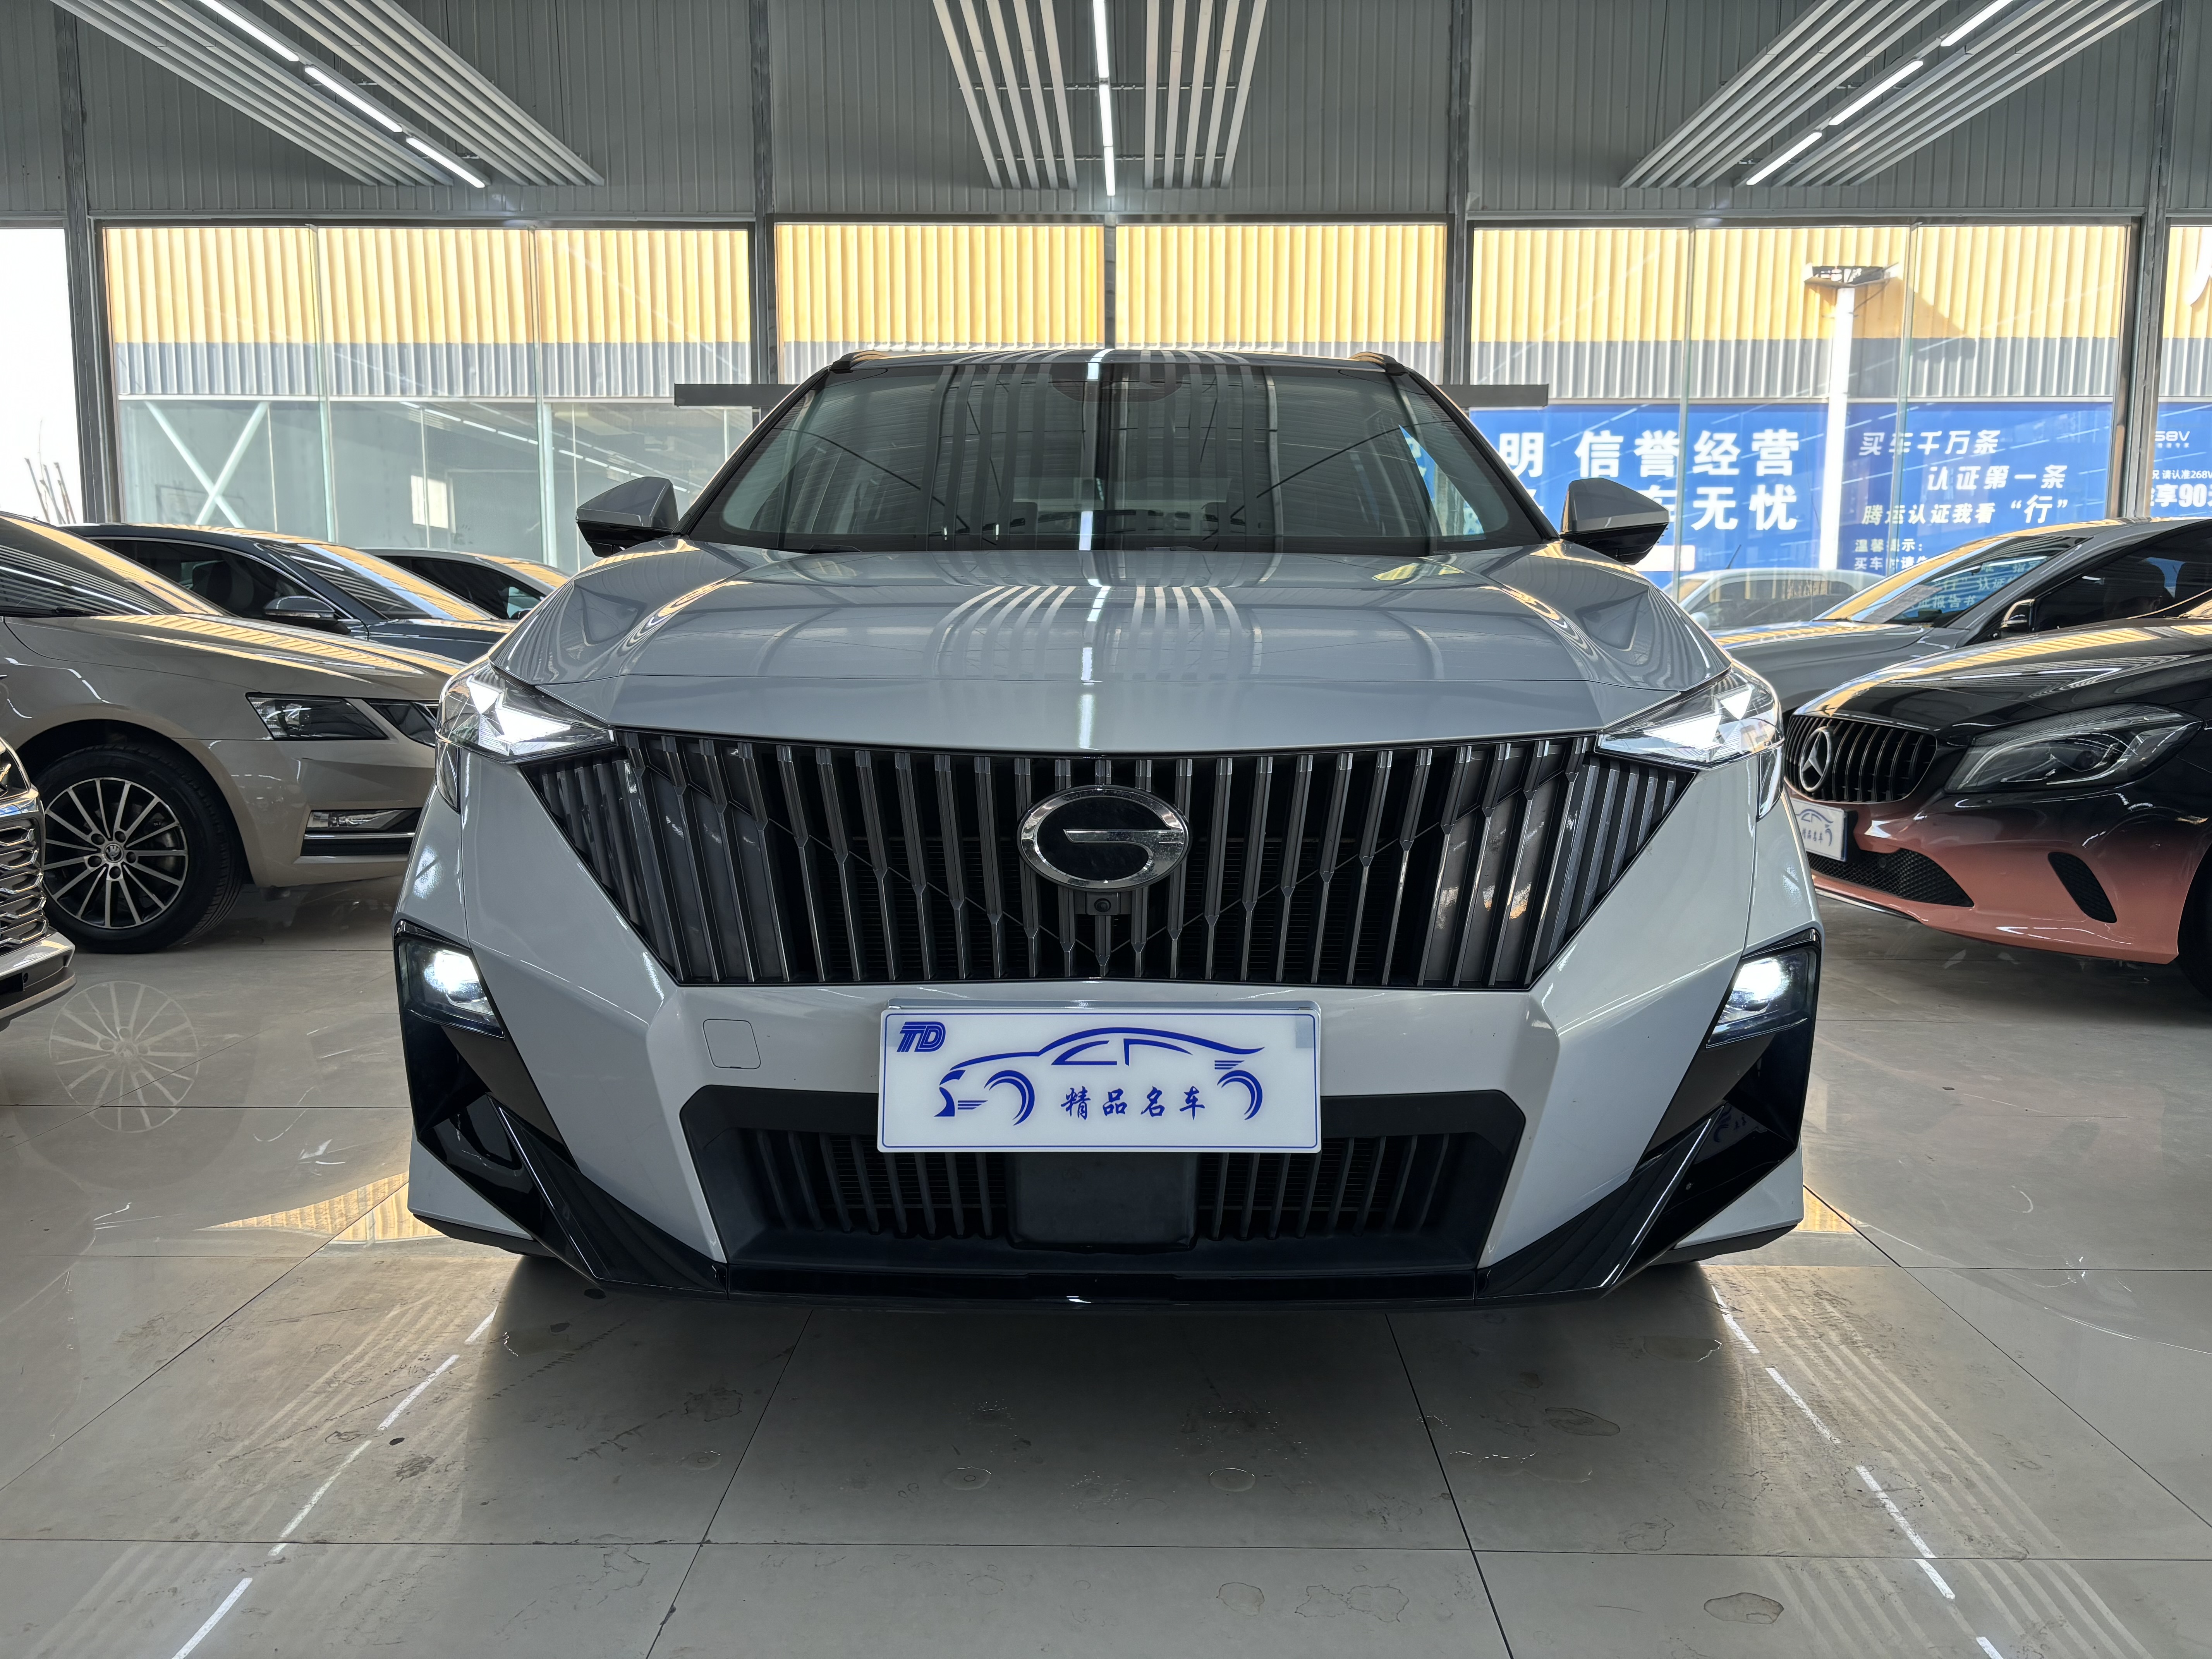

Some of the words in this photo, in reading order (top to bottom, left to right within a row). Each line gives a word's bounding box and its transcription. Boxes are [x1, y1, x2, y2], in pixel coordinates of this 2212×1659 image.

[1574, 429, 1799, 478] 信誉经营
[1859, 430, 2001, 456] 买车千万条
[1928, 465, 2068, 489] 认证第一条
[896, 1020, 946, 1053] TD
[1060, 1085, 1206, 1120] 精品名车
